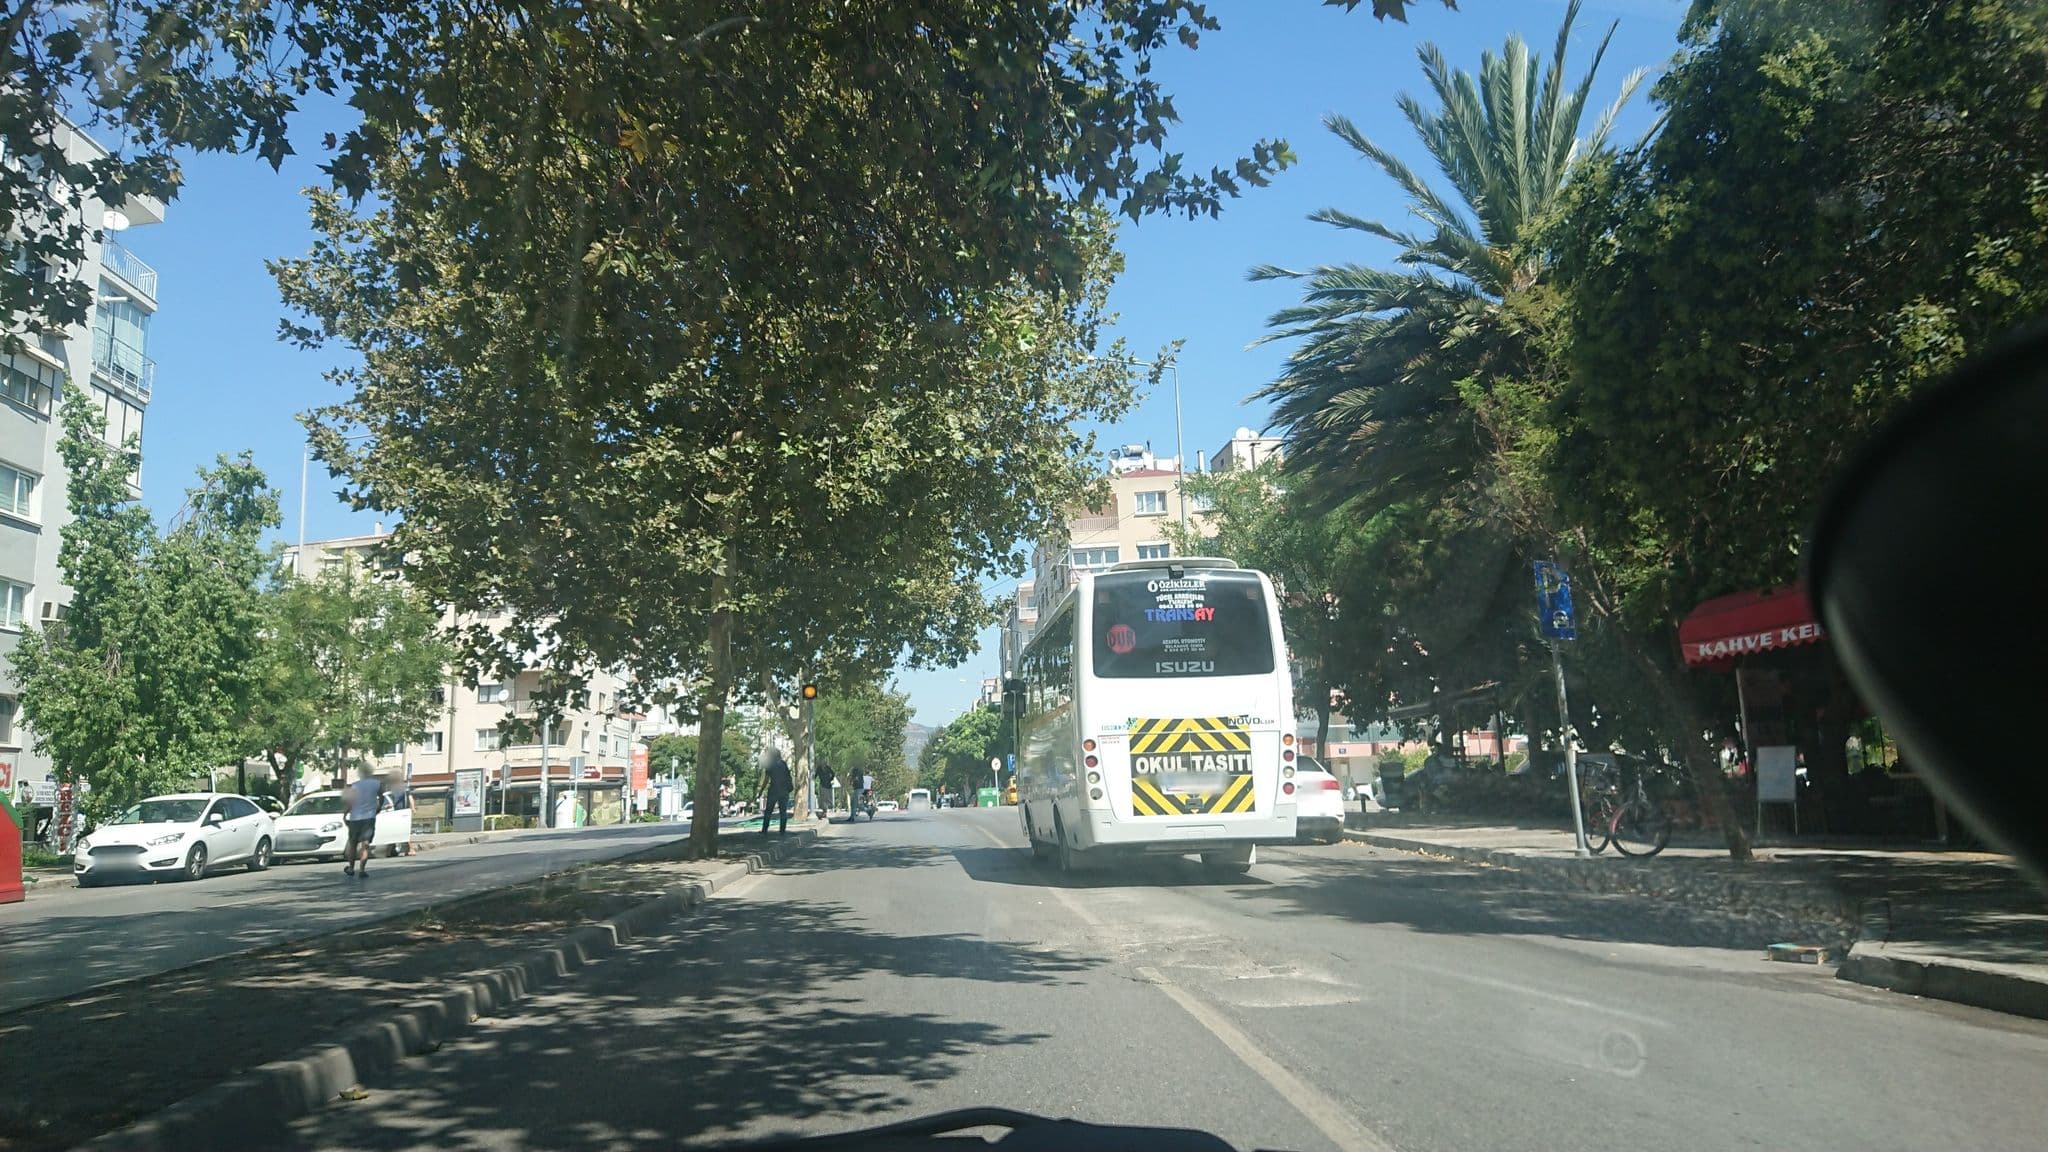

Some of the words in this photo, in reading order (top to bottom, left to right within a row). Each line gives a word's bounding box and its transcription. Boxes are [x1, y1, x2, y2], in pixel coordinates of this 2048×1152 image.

[1145, 608, 1216, 622] TRANSAY
[1699, 632, 1772, 656] KAHVE
[1156, 661, 1214, 672] ISUZU
[1136, 755, 1187, 774] OKUL
